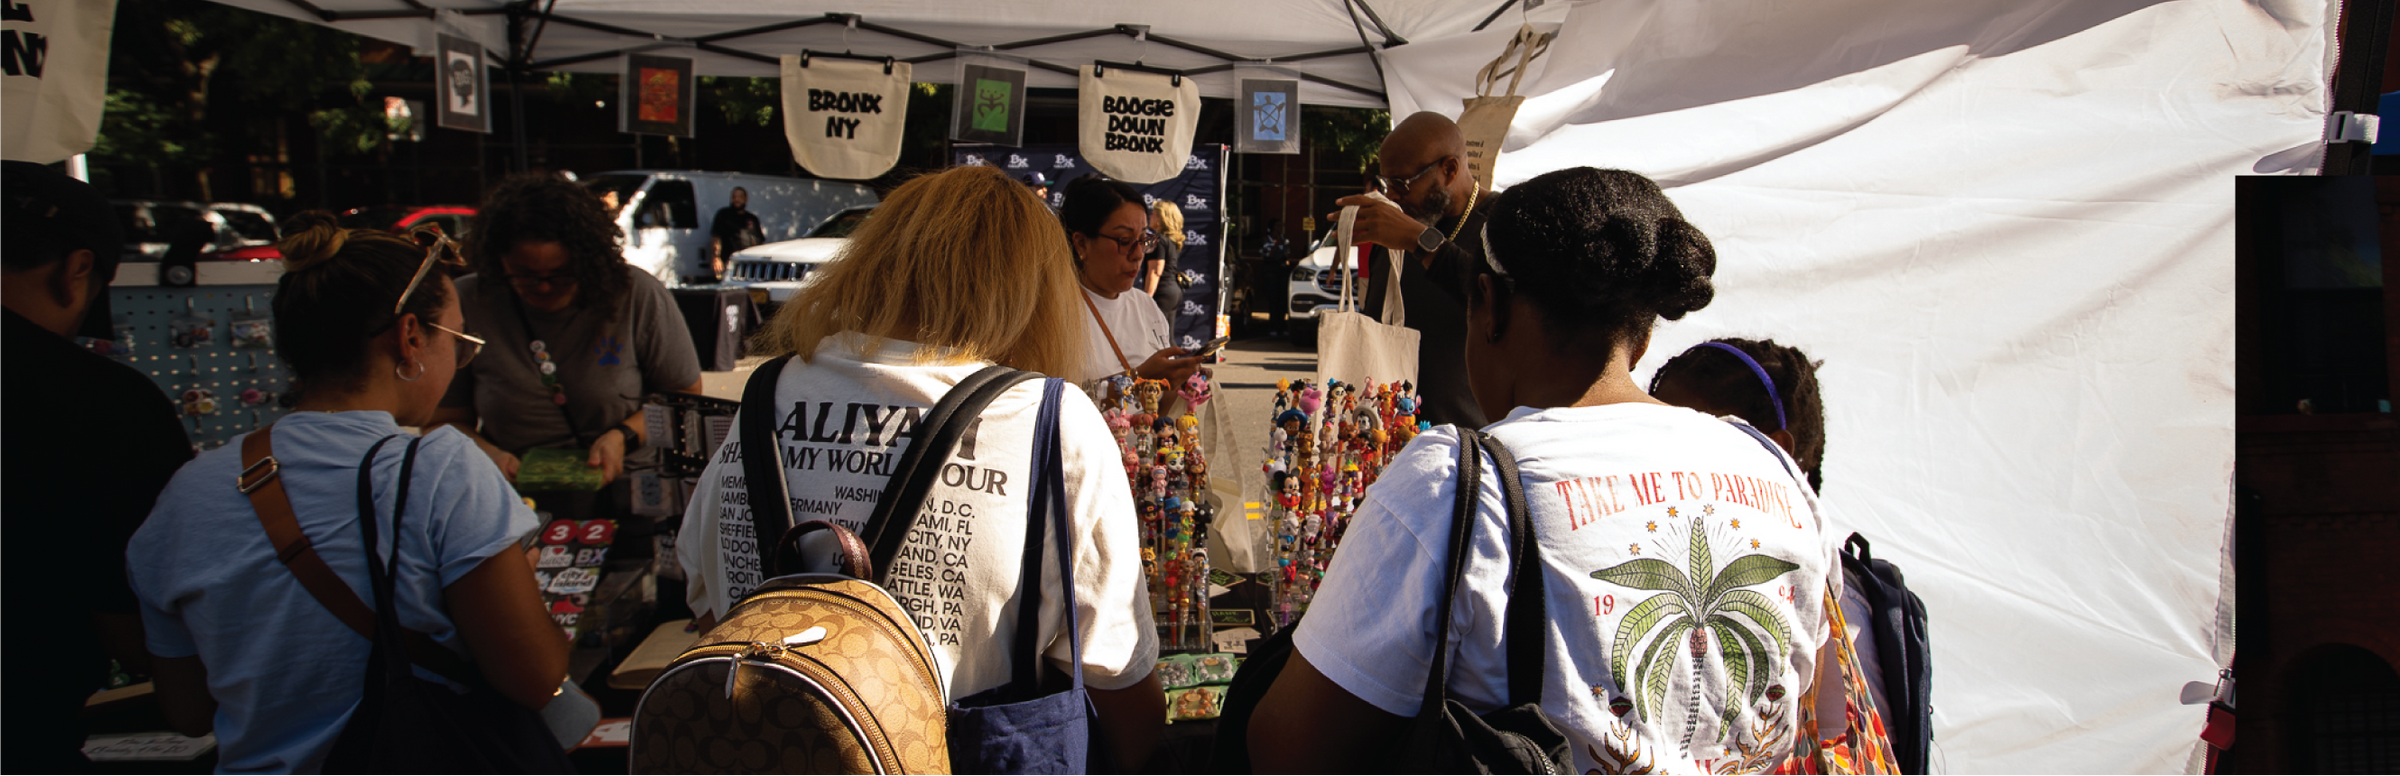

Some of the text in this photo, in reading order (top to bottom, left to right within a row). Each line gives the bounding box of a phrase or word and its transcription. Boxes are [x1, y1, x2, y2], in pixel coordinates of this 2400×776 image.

[808, 89, 882, 114] BRONX
[826, 116, 860, 139] NY
[1108, 115, 1166, 136] DOWN
[1105, 132, 1164, 154] BRONX
[784, 446, 823, 470] MY
[827, 448, 895, 477] WORL
[941, 500, 975, 519] D.C.
[1554, 471, 1802, 531] TAKE ME TO PARADISE
[550, 525, 605, 541] 3 2
[956, 519, 973, 536] FL
[907, 529, 972, 552] CITY, NY
[575, 547, 609, 564] BX
[943, 553, 969, 569] CA
[941, 569, 967, 585] CA
[938, 584, 965, 601] WA
[1593, 585, 1796, 617] 19 94
[942, 602, 963, 616] PA
[939, 617, 961, 632] VA
[939, 633, 960, 646] PA
